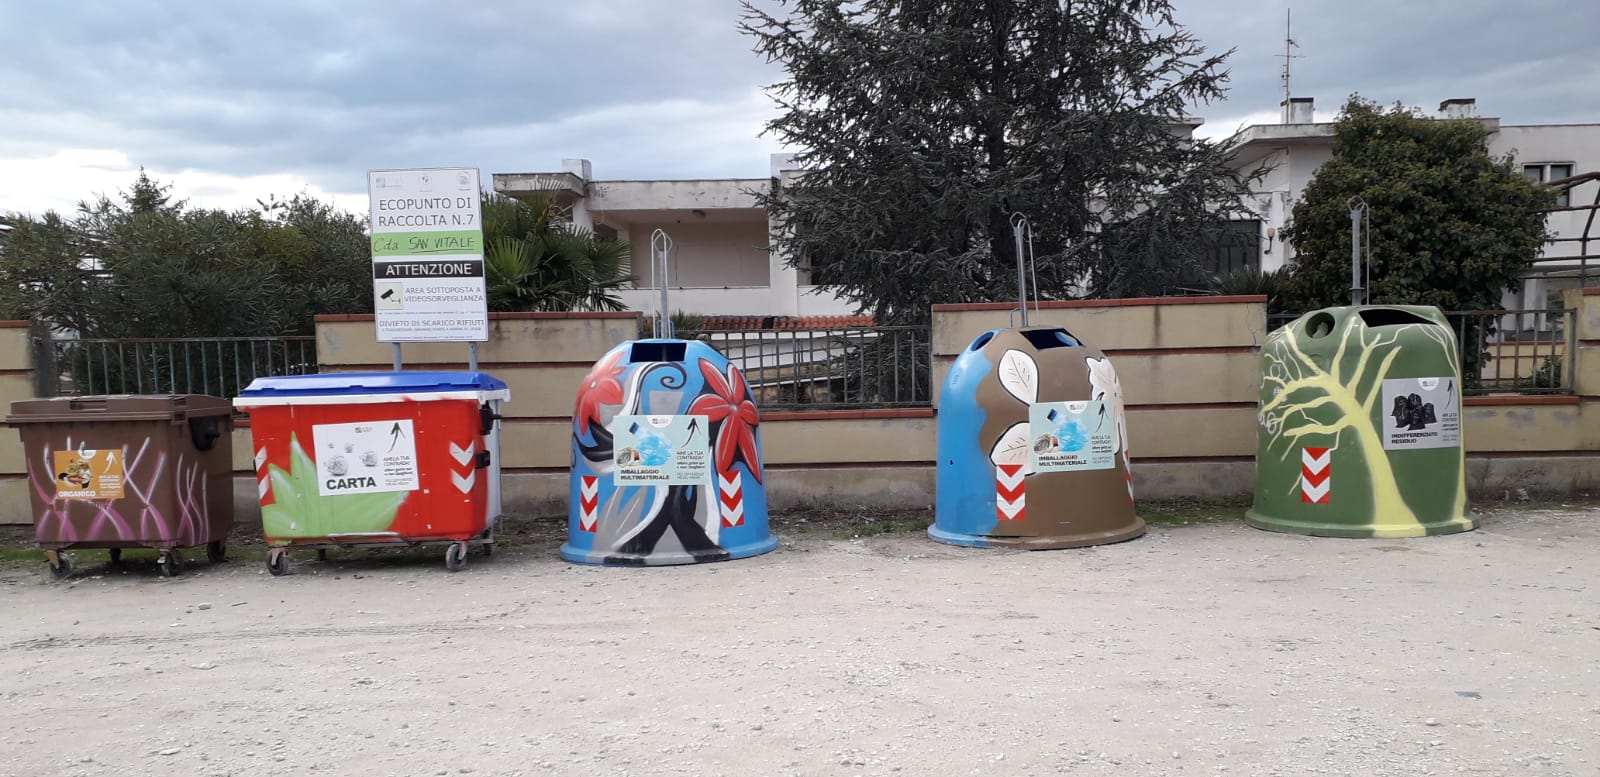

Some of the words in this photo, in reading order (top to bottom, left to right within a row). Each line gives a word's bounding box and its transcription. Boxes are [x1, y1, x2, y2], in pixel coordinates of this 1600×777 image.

[379, 198, 452, 211] ECOPUNTO
[457, 197, 472, 209] DI
[378, 215, 447, 227] RACCOLTA
[452, 214, 474, 225] N.7
[373, 237, 400, 252] Cda
[434, 237, 475, 249] VITALE
[385, 263, 473, 276] ATTENZIONE
[426, 286, 474, 294] SOTTOPOSTA
[404, 295, 483, 303] VIDEOSORVEGLIANZA
[422, 319, 455, 327] SCARICO
[326, 476, 377, 490] CARTA
